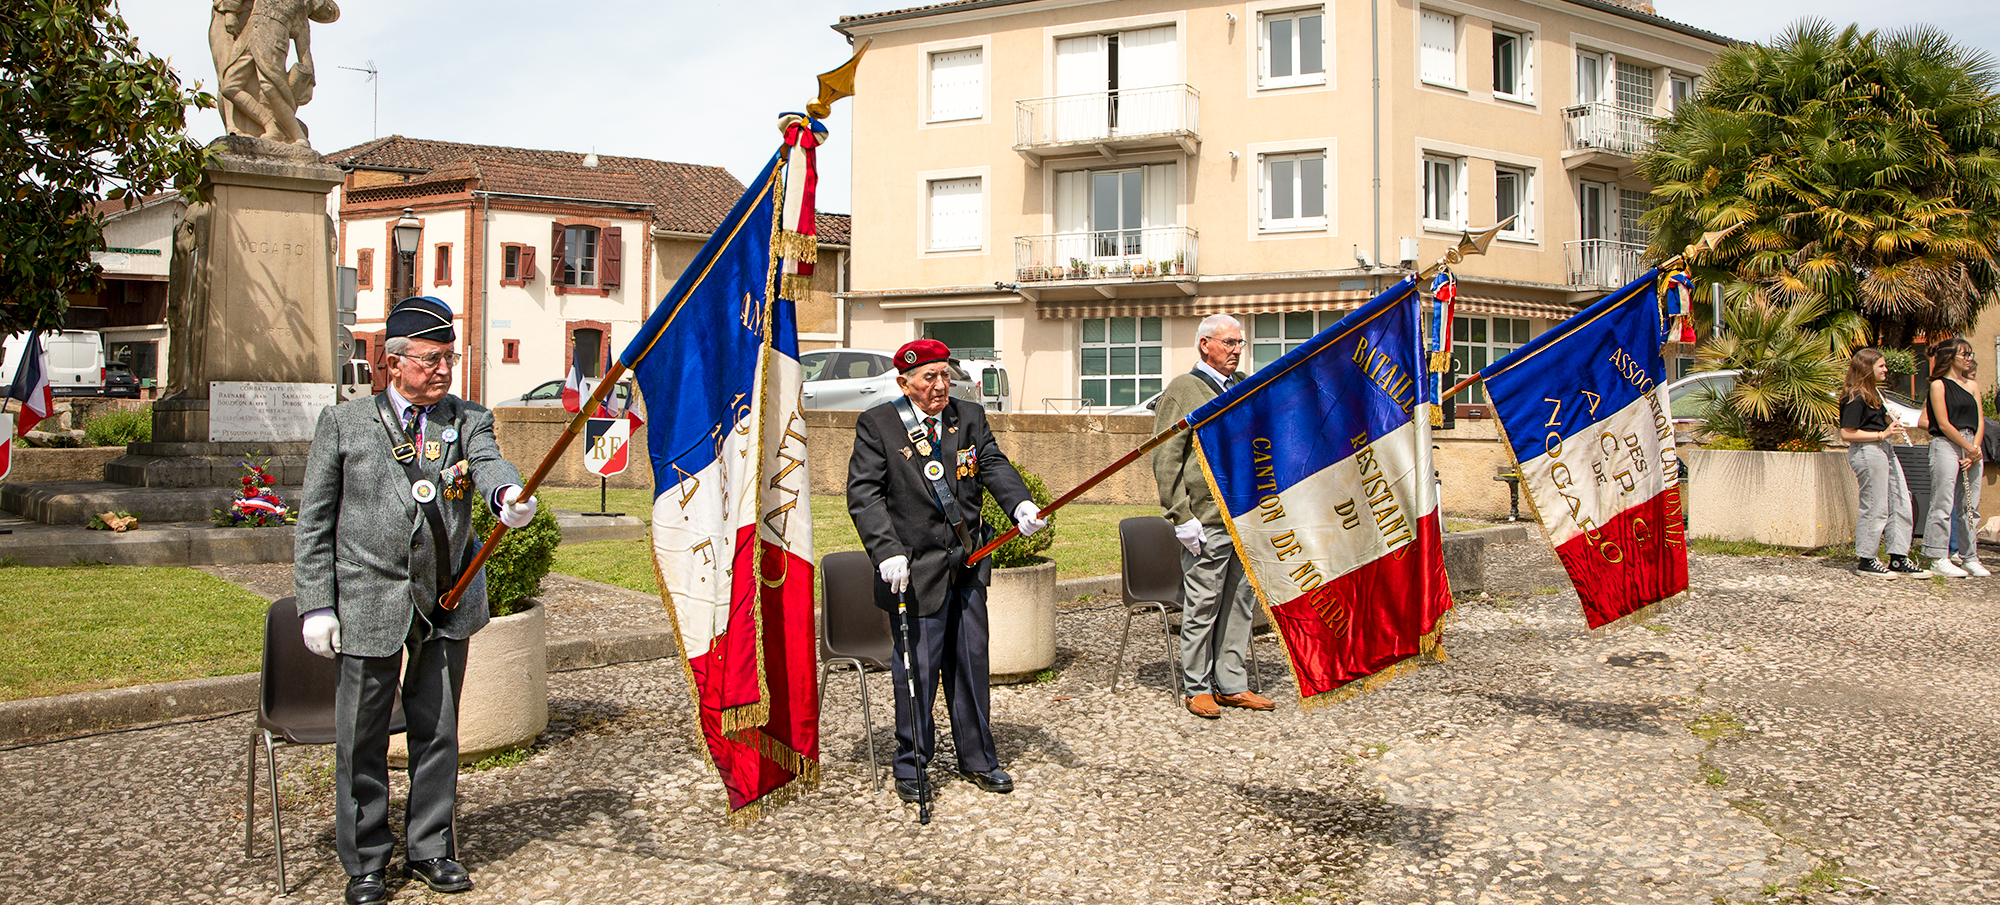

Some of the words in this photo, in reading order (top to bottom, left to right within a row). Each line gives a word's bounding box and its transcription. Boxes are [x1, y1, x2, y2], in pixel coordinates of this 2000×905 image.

[120, 247, 162, 255] NOGARO
[237, 241, 304, 256] NOGARO
[1352, 335, 1415, 425] BATAILL
[1609, 347, 1673, 442] ASSOCIATION
[592, 435, 621, 461] RF
[1623, 432, 1648, 473] DES
[1544, 397, 1624, 565] NOGARO
[1592, 460, 1608, 487] DE
[1334, 497, 1361, 531] DU
[1350, 430, 1417, 561] RESISTANTS
[1252, 437, 1286, 523] CANTON
[1271, 529, 1303, 561] DE
[1289, 560, 1350, 639] NOGARO
